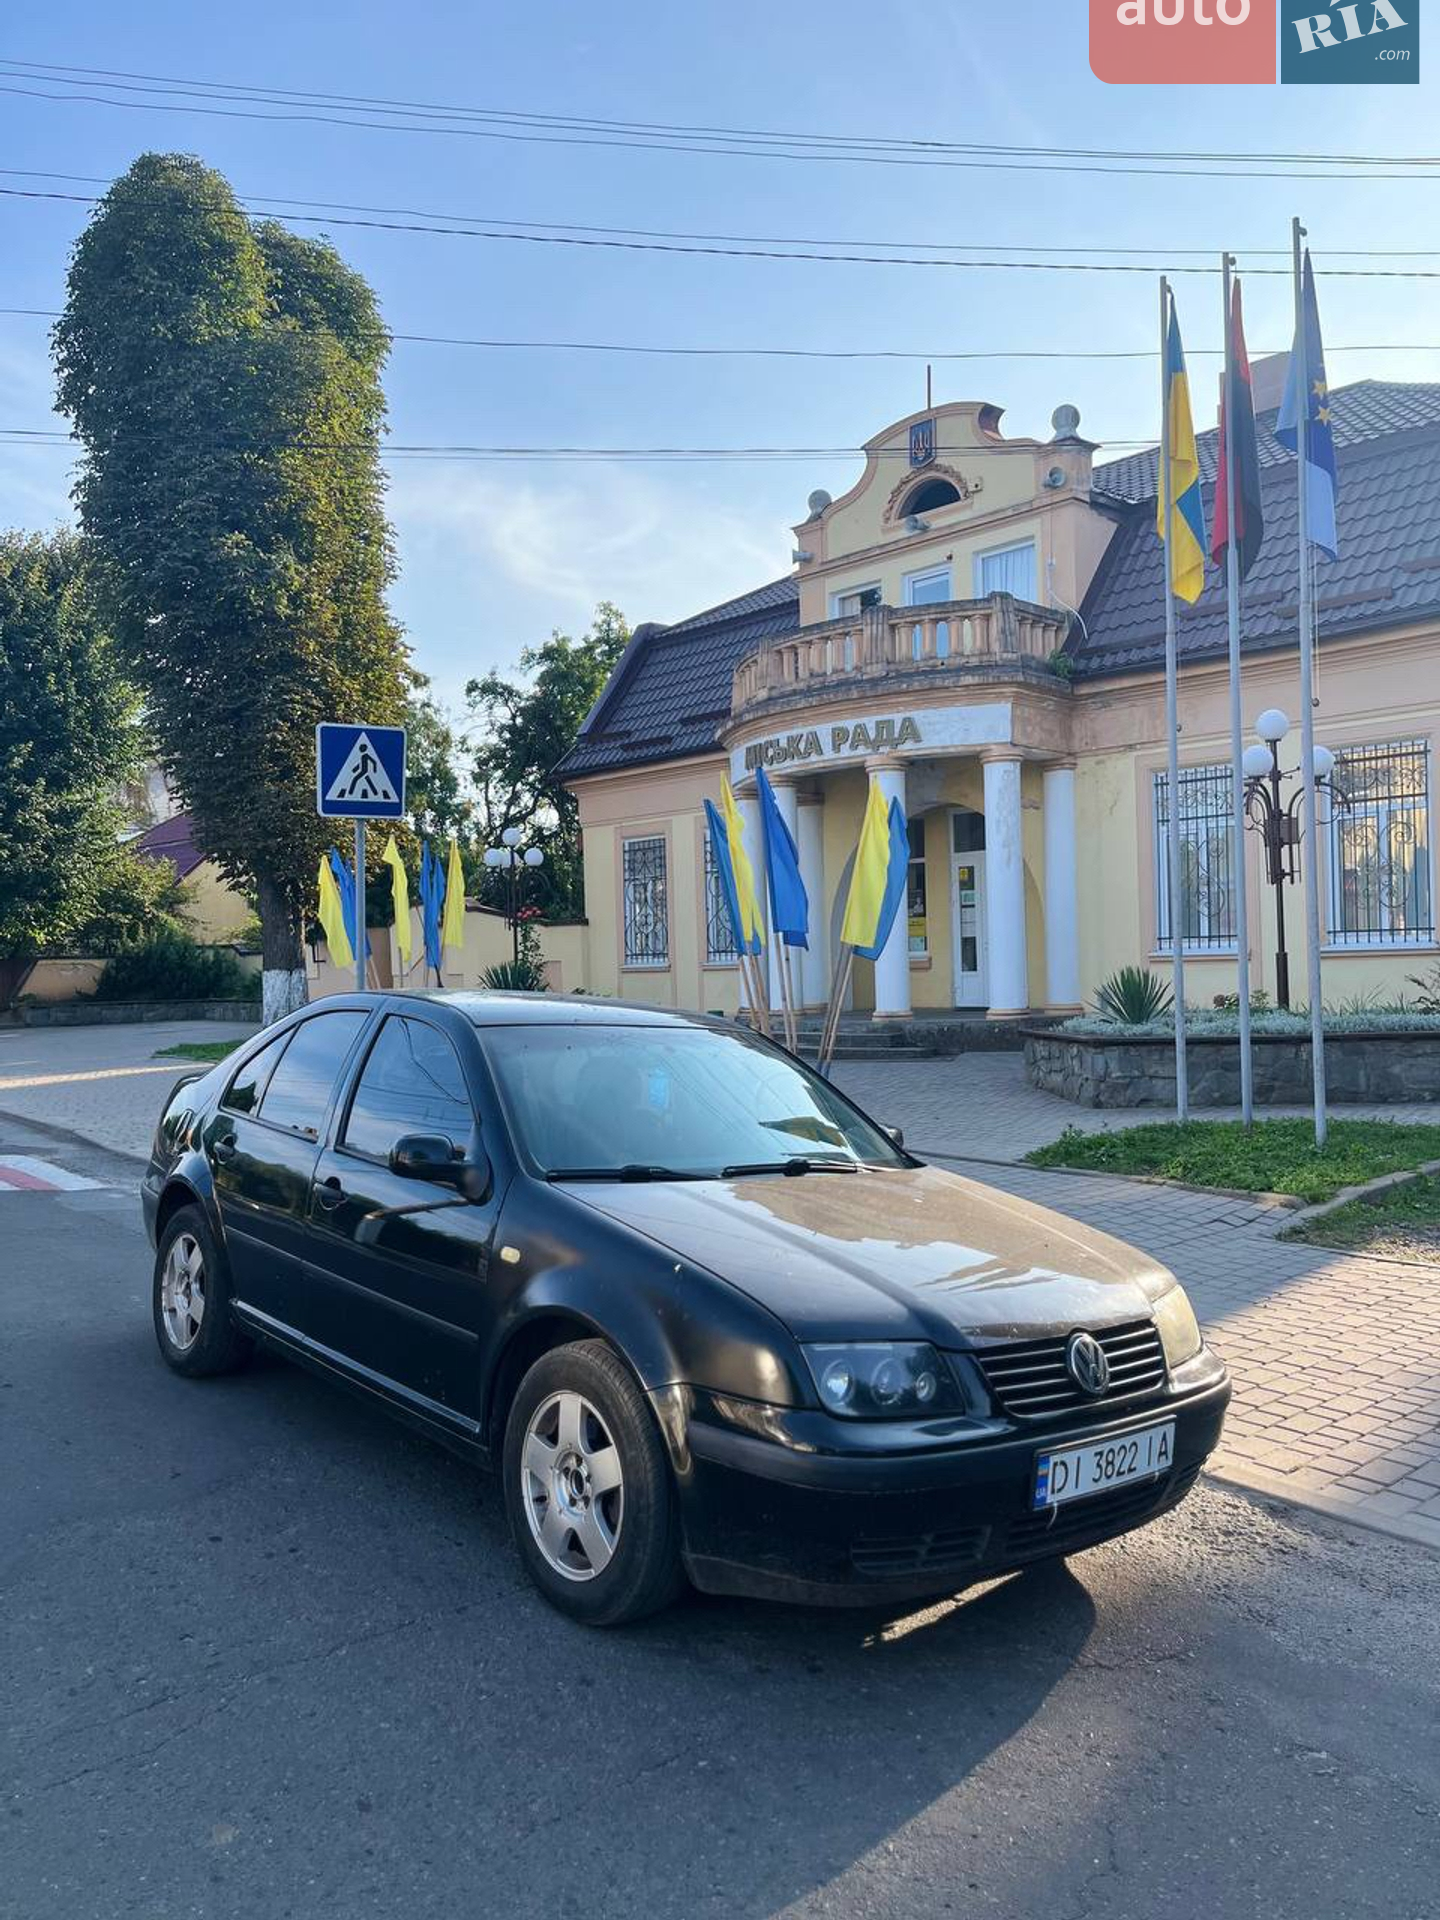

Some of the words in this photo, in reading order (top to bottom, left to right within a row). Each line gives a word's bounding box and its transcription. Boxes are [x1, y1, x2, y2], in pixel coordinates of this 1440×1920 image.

[830, 716, 923, 753] РАДА
[1051, 1455, 1081, 1495] DI
[1092, 1441, 1139, 1484] 3822
[1147, 1430, 1169, 1467] IA
